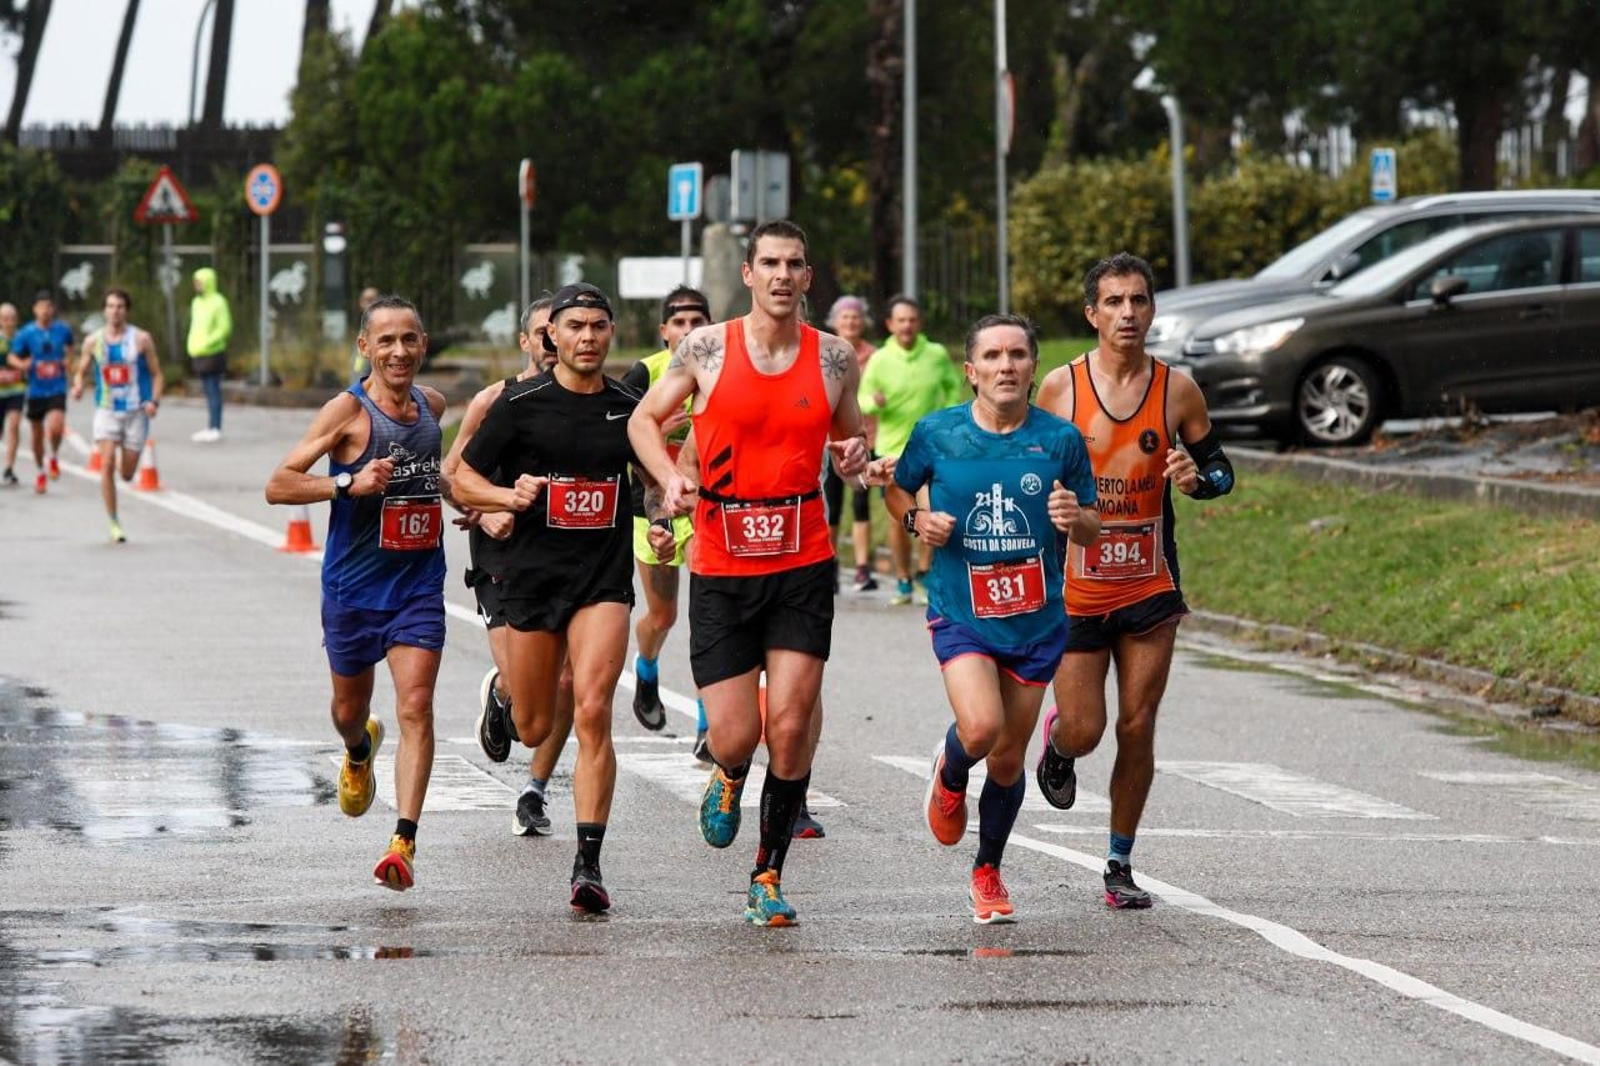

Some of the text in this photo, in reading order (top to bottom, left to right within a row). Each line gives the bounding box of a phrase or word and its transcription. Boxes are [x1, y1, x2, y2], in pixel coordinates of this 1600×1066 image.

[564, 490, 604, 513] 320
[975, 492, 990, 507] 21
[1096, 496, 1138, 517] MOAÑA
[399, 513, 430, 535] 162
[742, 514, 784, 538] 332
[963, 538, 1036, 552] COSTA DA SOAVELA
[1100, 542, 1140, 564] 394
[987, 574, 1026, 601] 331
